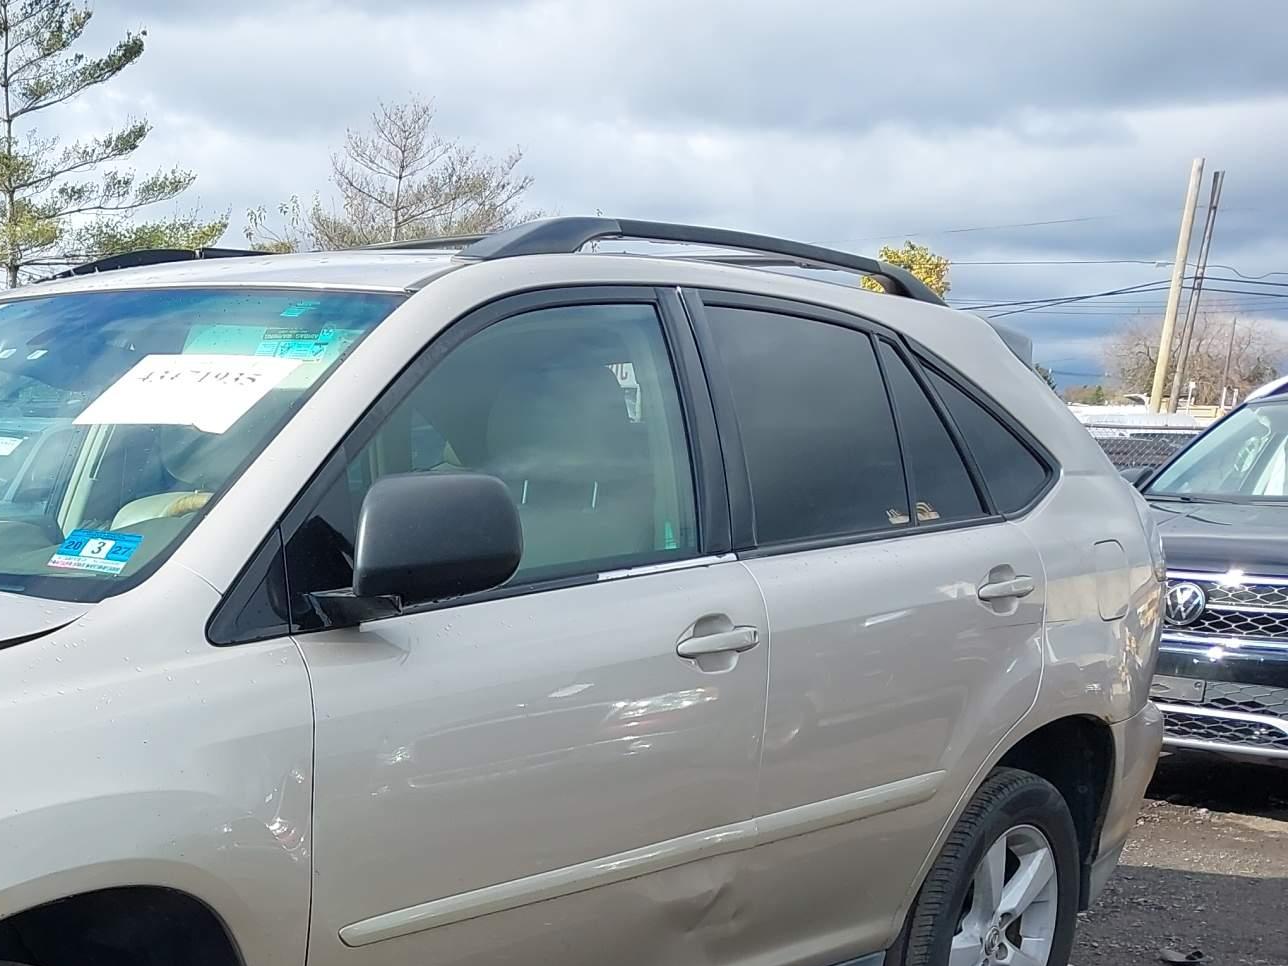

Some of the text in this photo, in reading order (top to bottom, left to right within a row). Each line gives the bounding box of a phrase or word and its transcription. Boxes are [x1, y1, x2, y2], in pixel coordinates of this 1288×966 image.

[64, 540, 132, 556] 20 3 27
